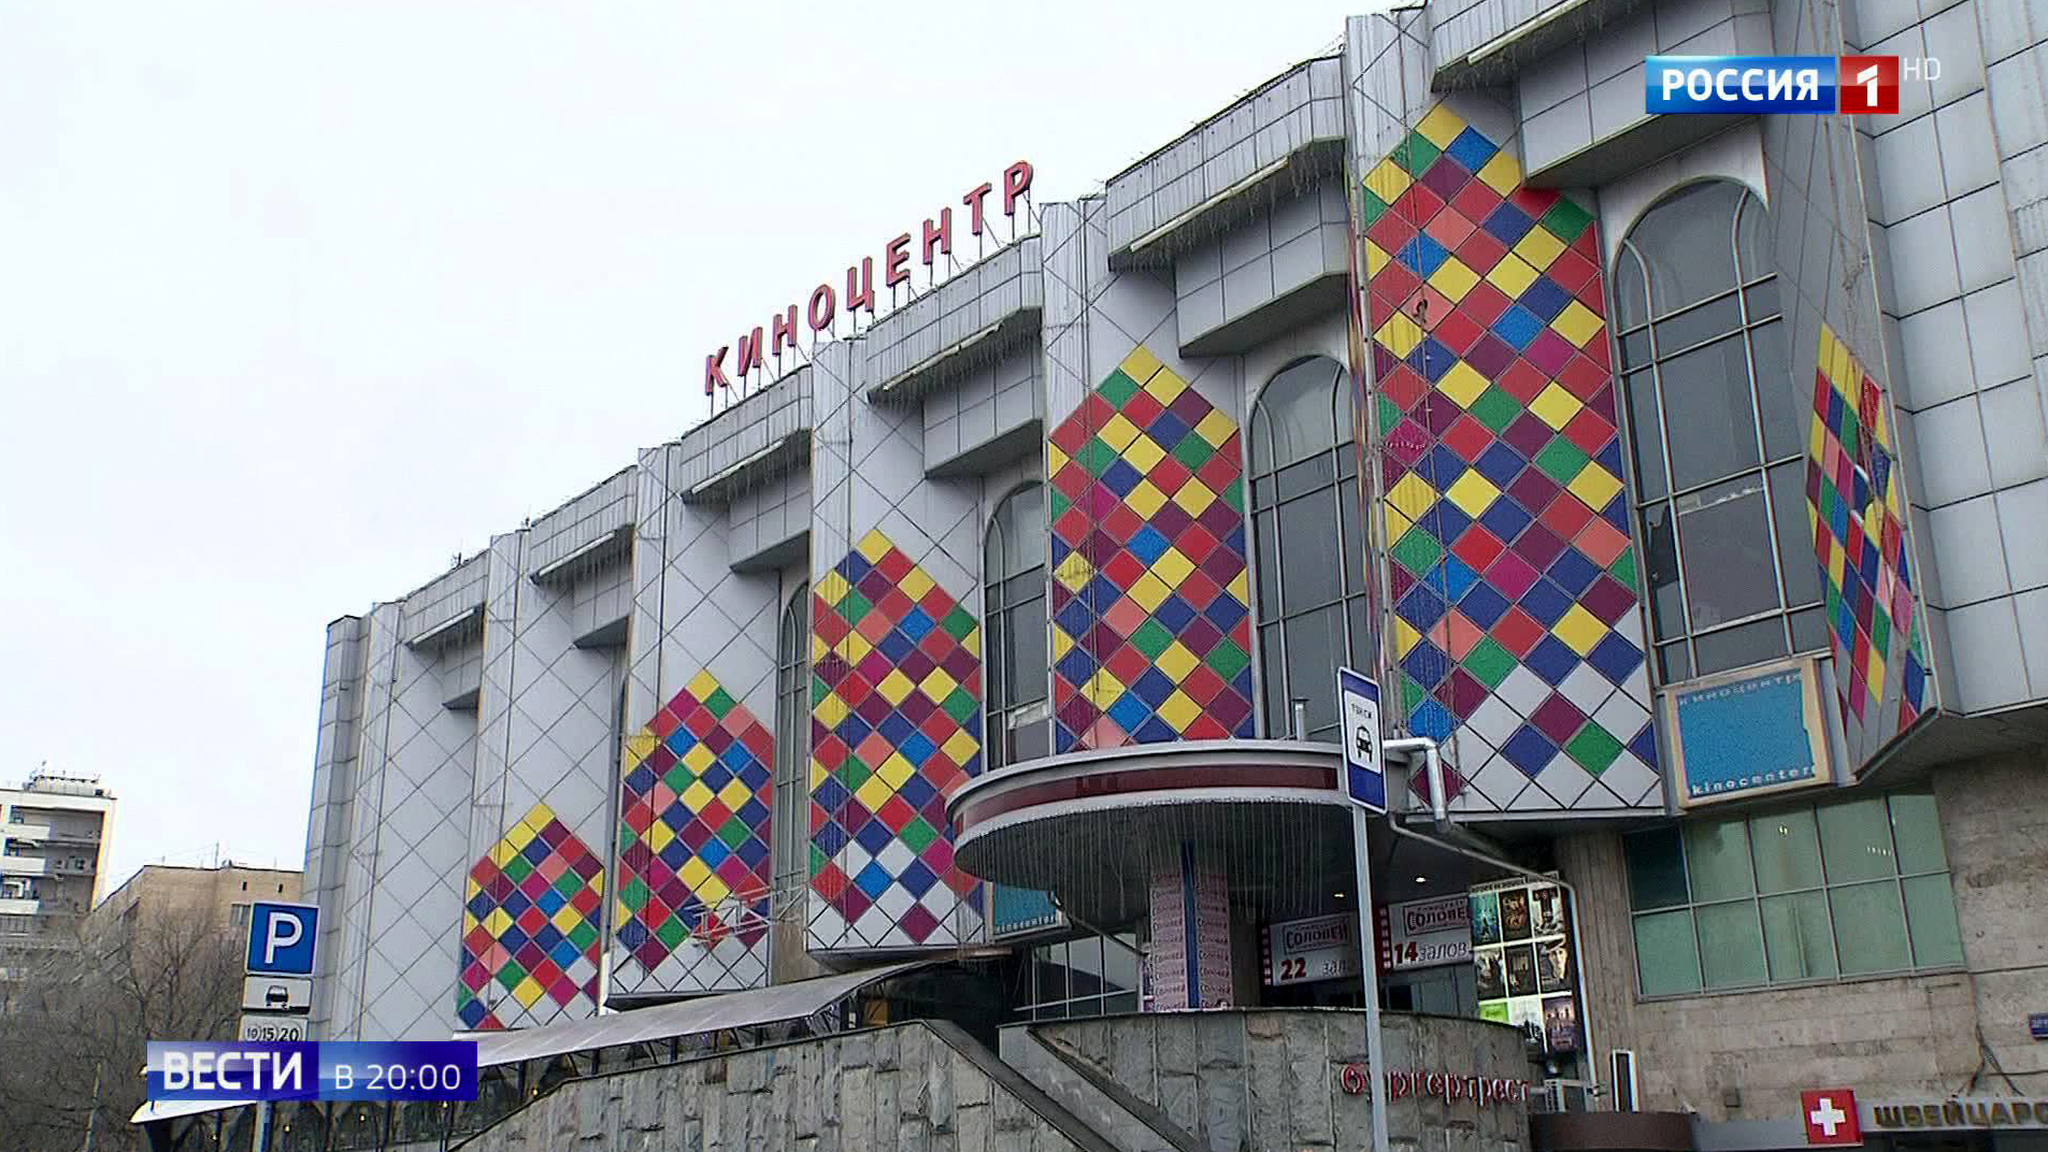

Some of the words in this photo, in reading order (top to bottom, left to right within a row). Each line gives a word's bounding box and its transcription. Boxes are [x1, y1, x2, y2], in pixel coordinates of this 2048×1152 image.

[705, 160, 1034, 396] КИНОЦЕНТР
[264, 911, 303, 964] P
[1394, 941, 1418, 964] 14
[1280, 957, 1307, 981] 22
[262, 1027, 275, 1041] 15
[279, 1027, 300, 1041] 20
